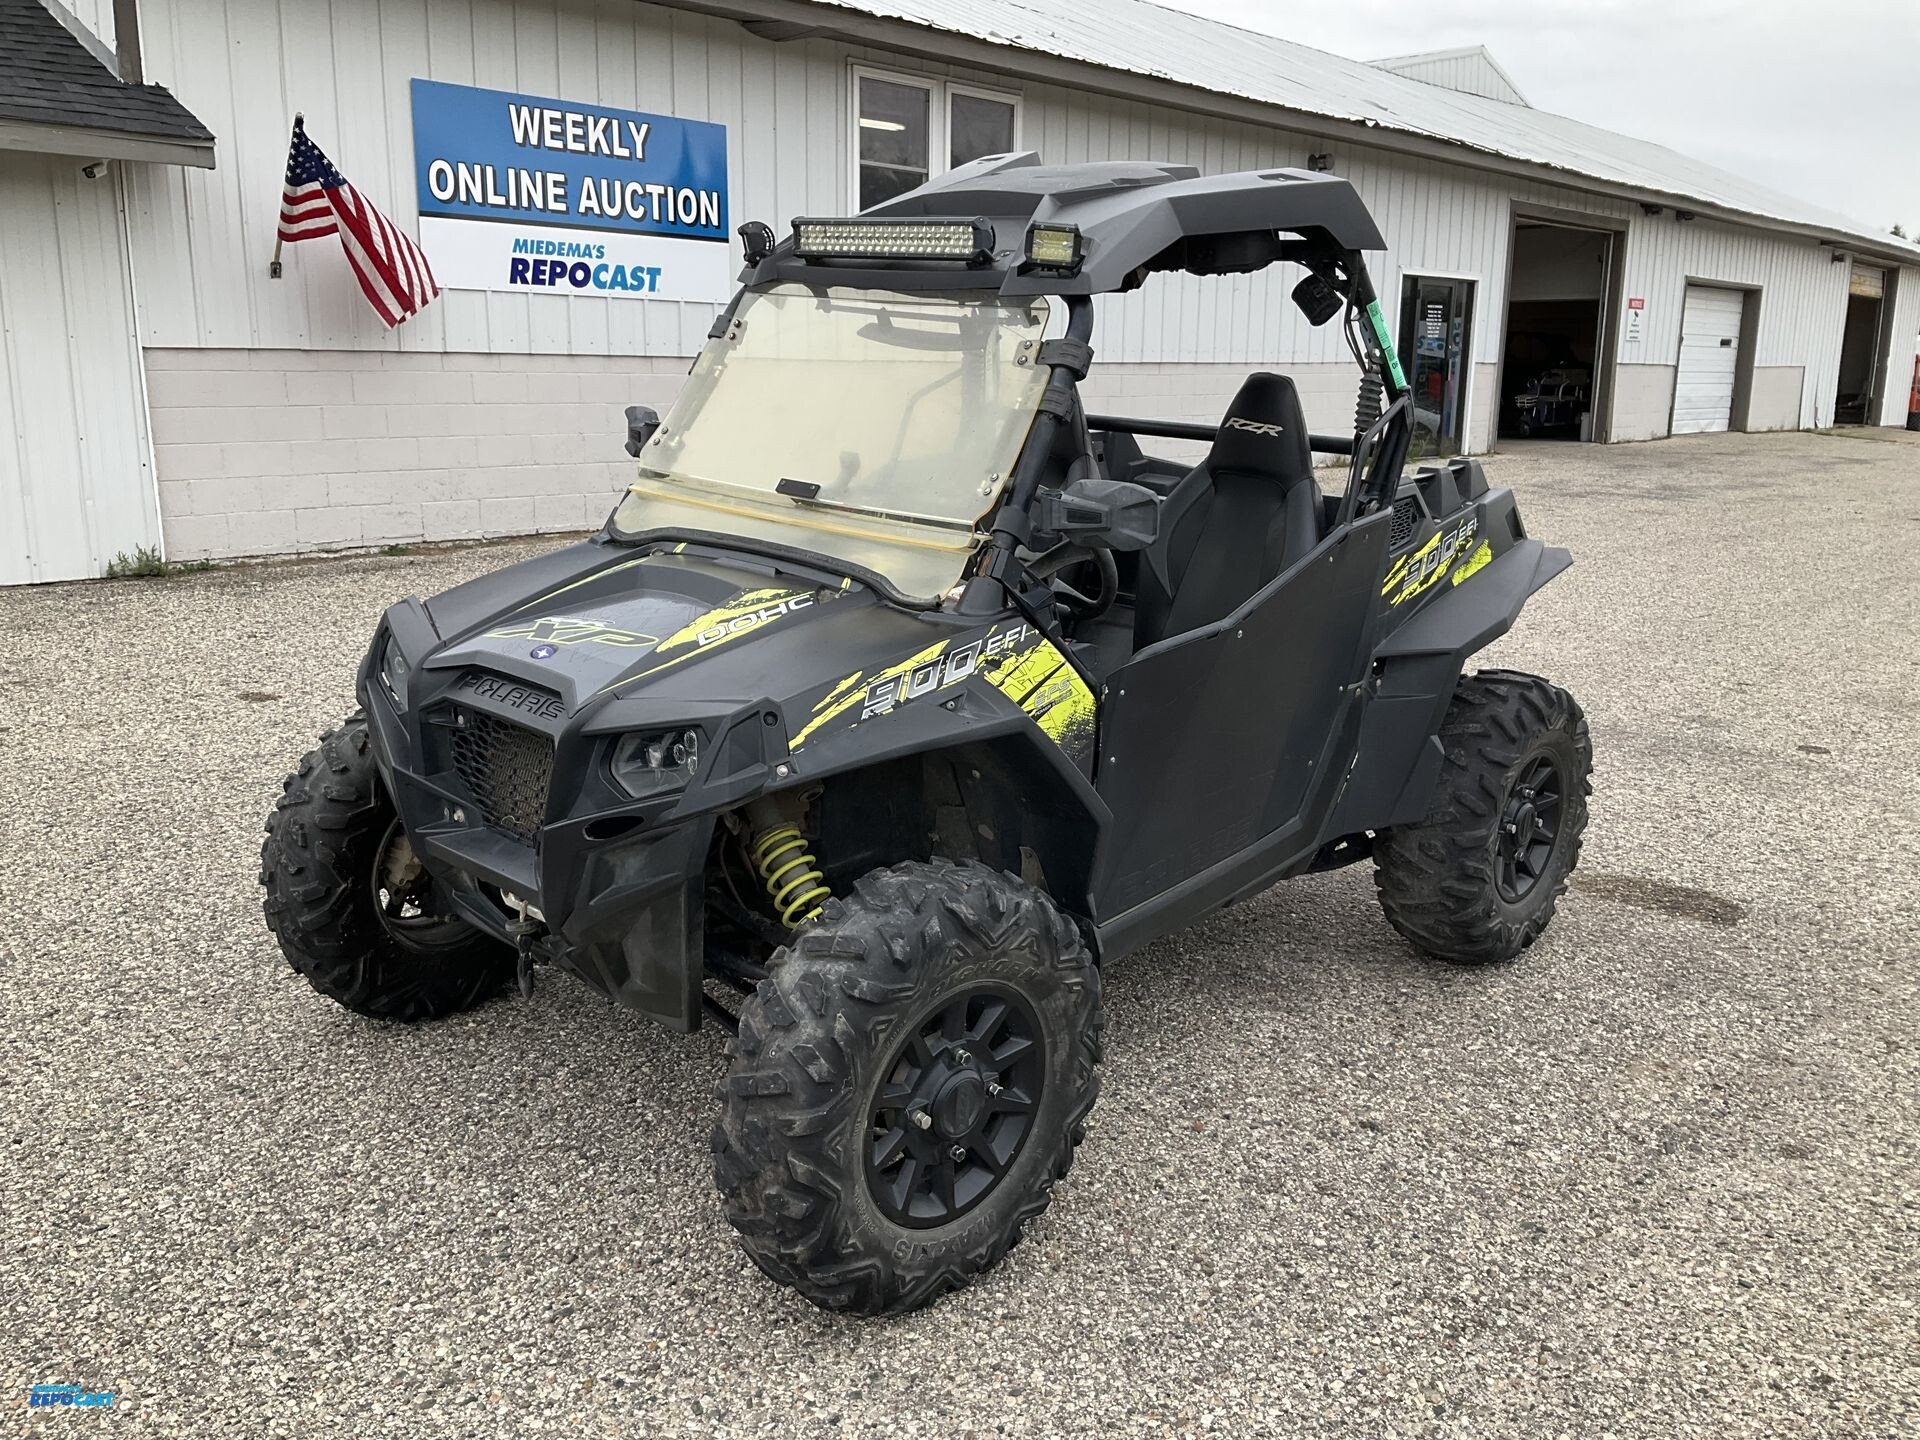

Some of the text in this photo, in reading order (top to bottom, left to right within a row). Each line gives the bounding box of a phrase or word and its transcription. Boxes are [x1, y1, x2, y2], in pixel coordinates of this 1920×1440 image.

[507, 103, 650, 161] WEEKLY
[428, 159, 720, 228] ONLINE AUCTION
[512, 238, 605, 259] MIEDEMA'S
[509, 257, 662, 293] REPOCAST
[1224, 417, 1284, 437] RZR
[1402, 517, 1477, 590] 900 EFI
[482, 615, 659, 647] XP
[696, 594, 814, 646] DOHC
[457, 672, 566, 721] POLARIS
[861, 624, 1027, 720] 900 EFI
